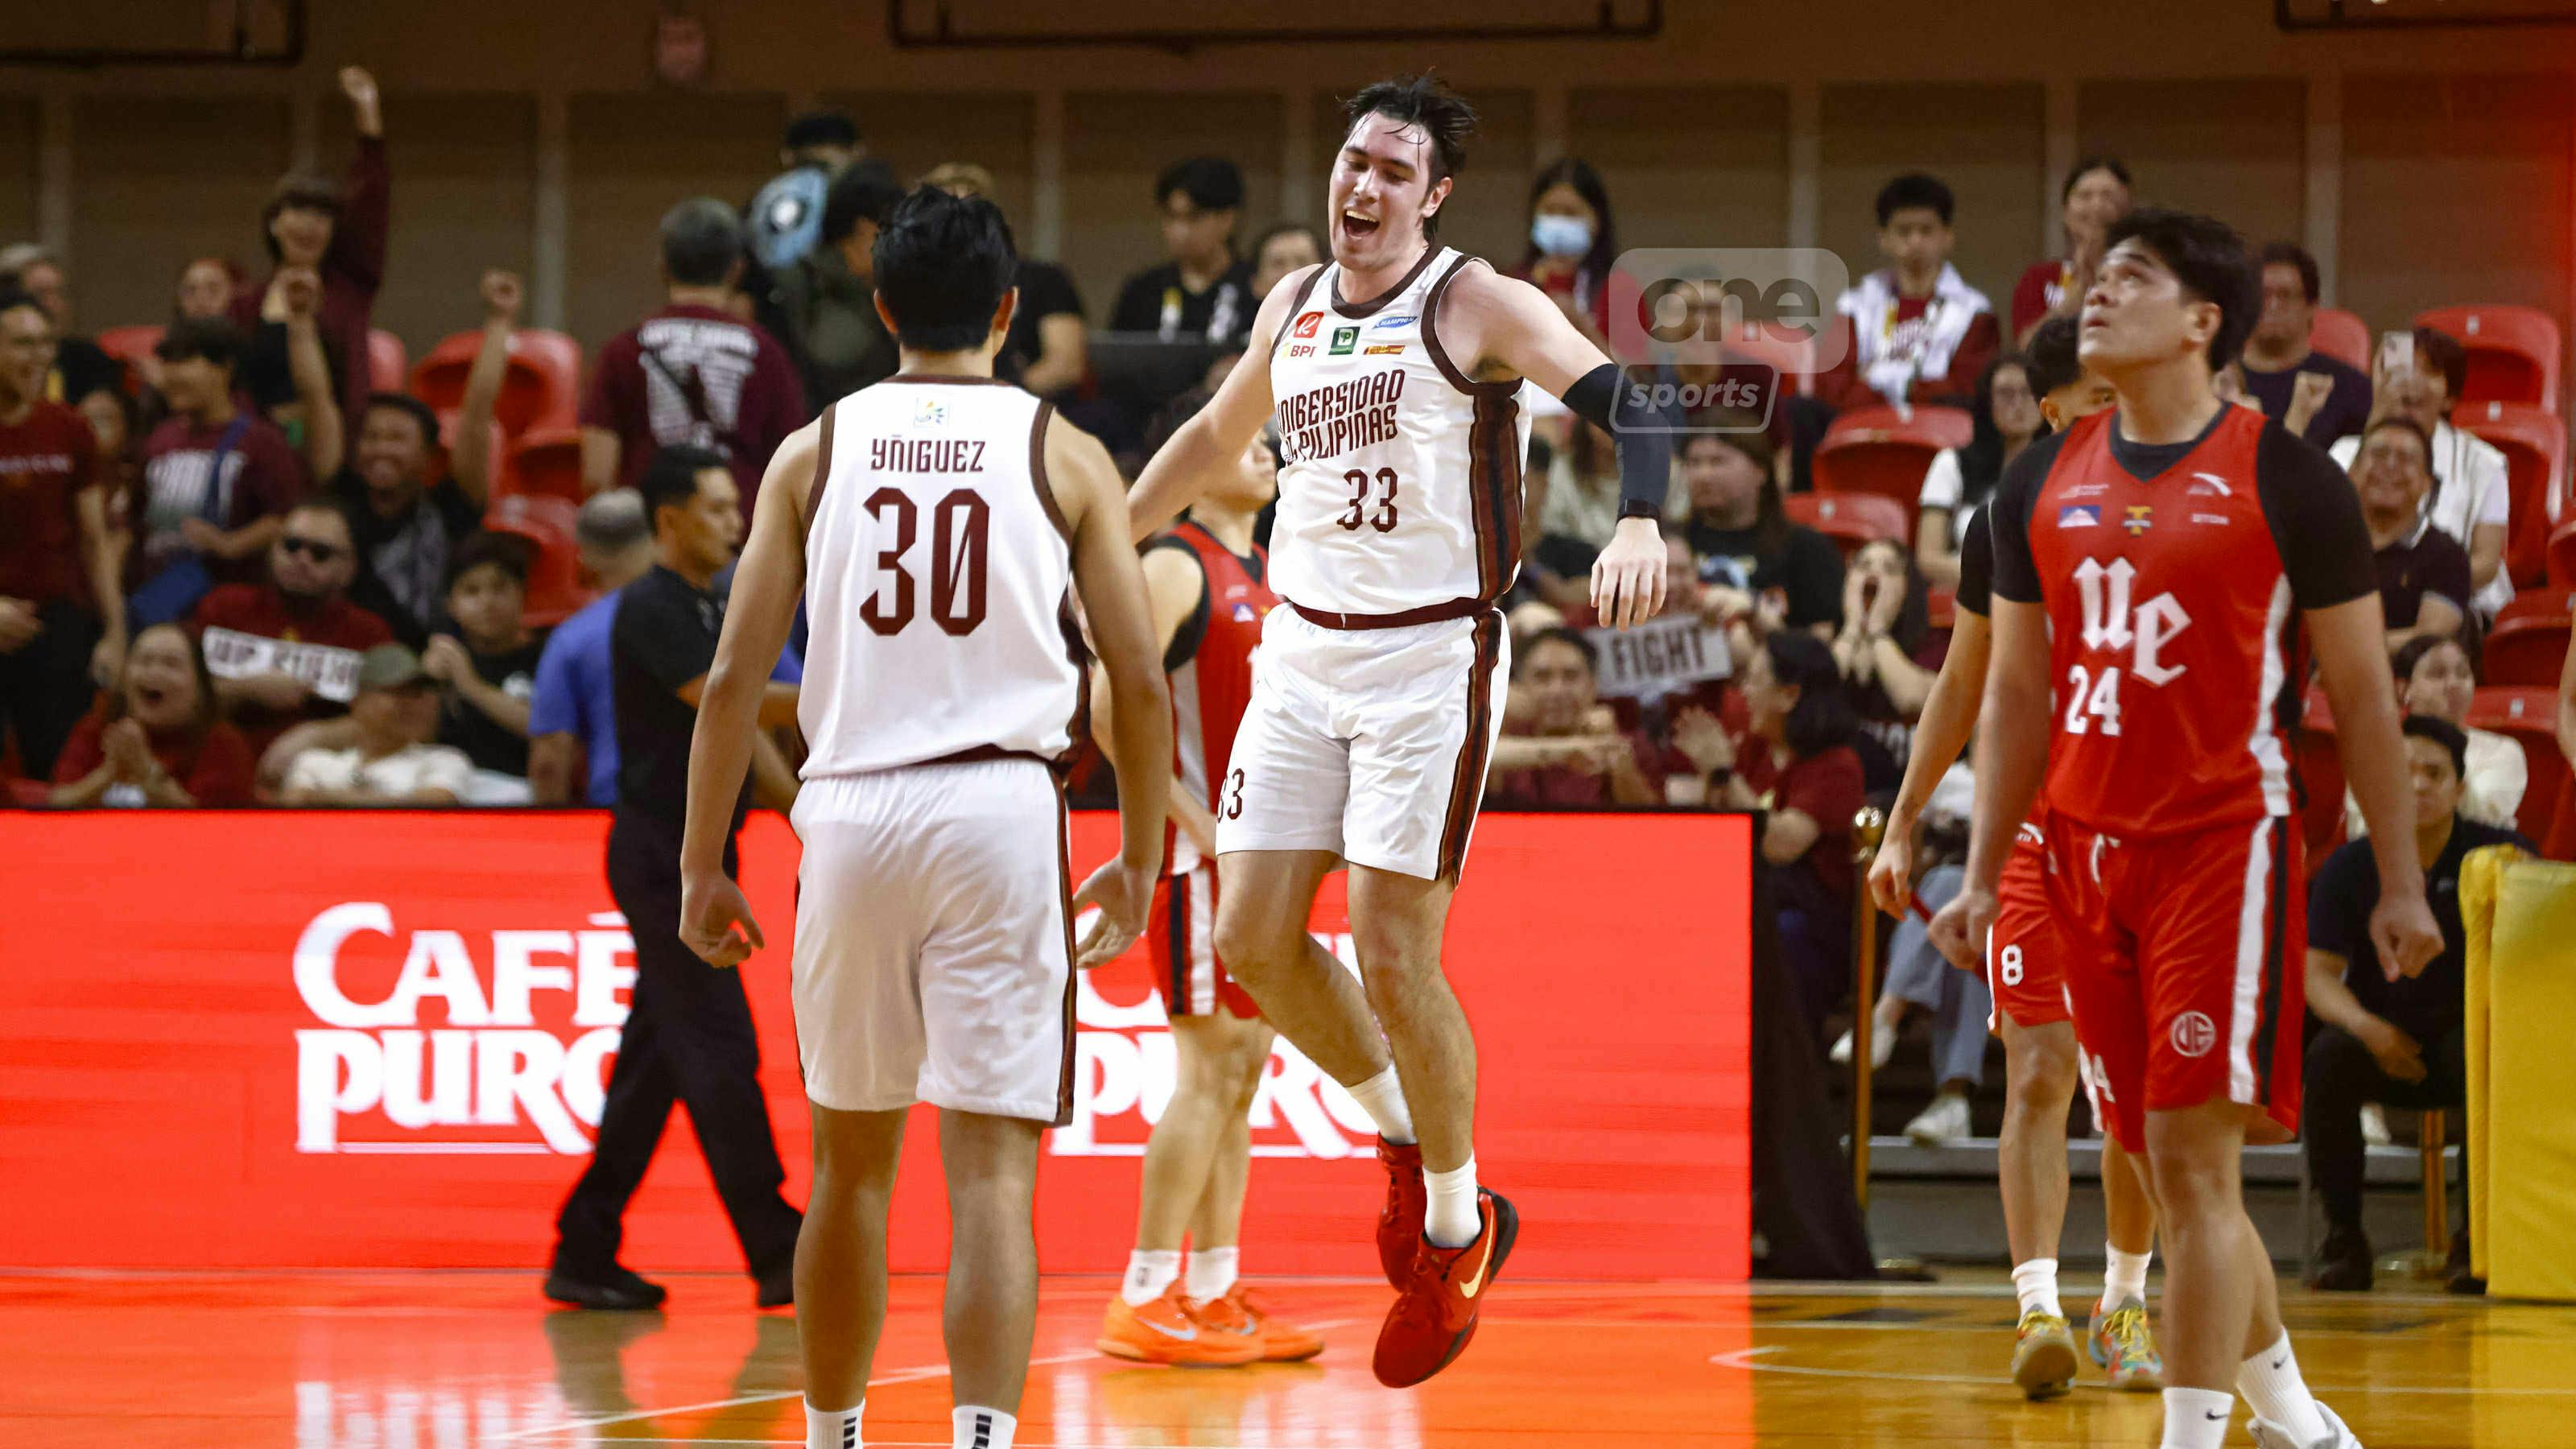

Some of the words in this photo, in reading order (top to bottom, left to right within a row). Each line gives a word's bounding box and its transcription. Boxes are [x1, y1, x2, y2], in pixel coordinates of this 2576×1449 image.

[1290, 345, 1317, 357] BPI
[1278, 369, 1406, 436] NIBERSIDAD
[870, 434, 986, 473] YÑIGUEZ
[1298, 404, 1398, 462] PILIPINAS
[1336, 467, 1398, 533] 33
[859, 486, 990, 636] 30
[1612, 624, 1705, 680] FIGHT
[2065, 664, 2122, 737] 24
[2000, 943, 2025, 987] 8
